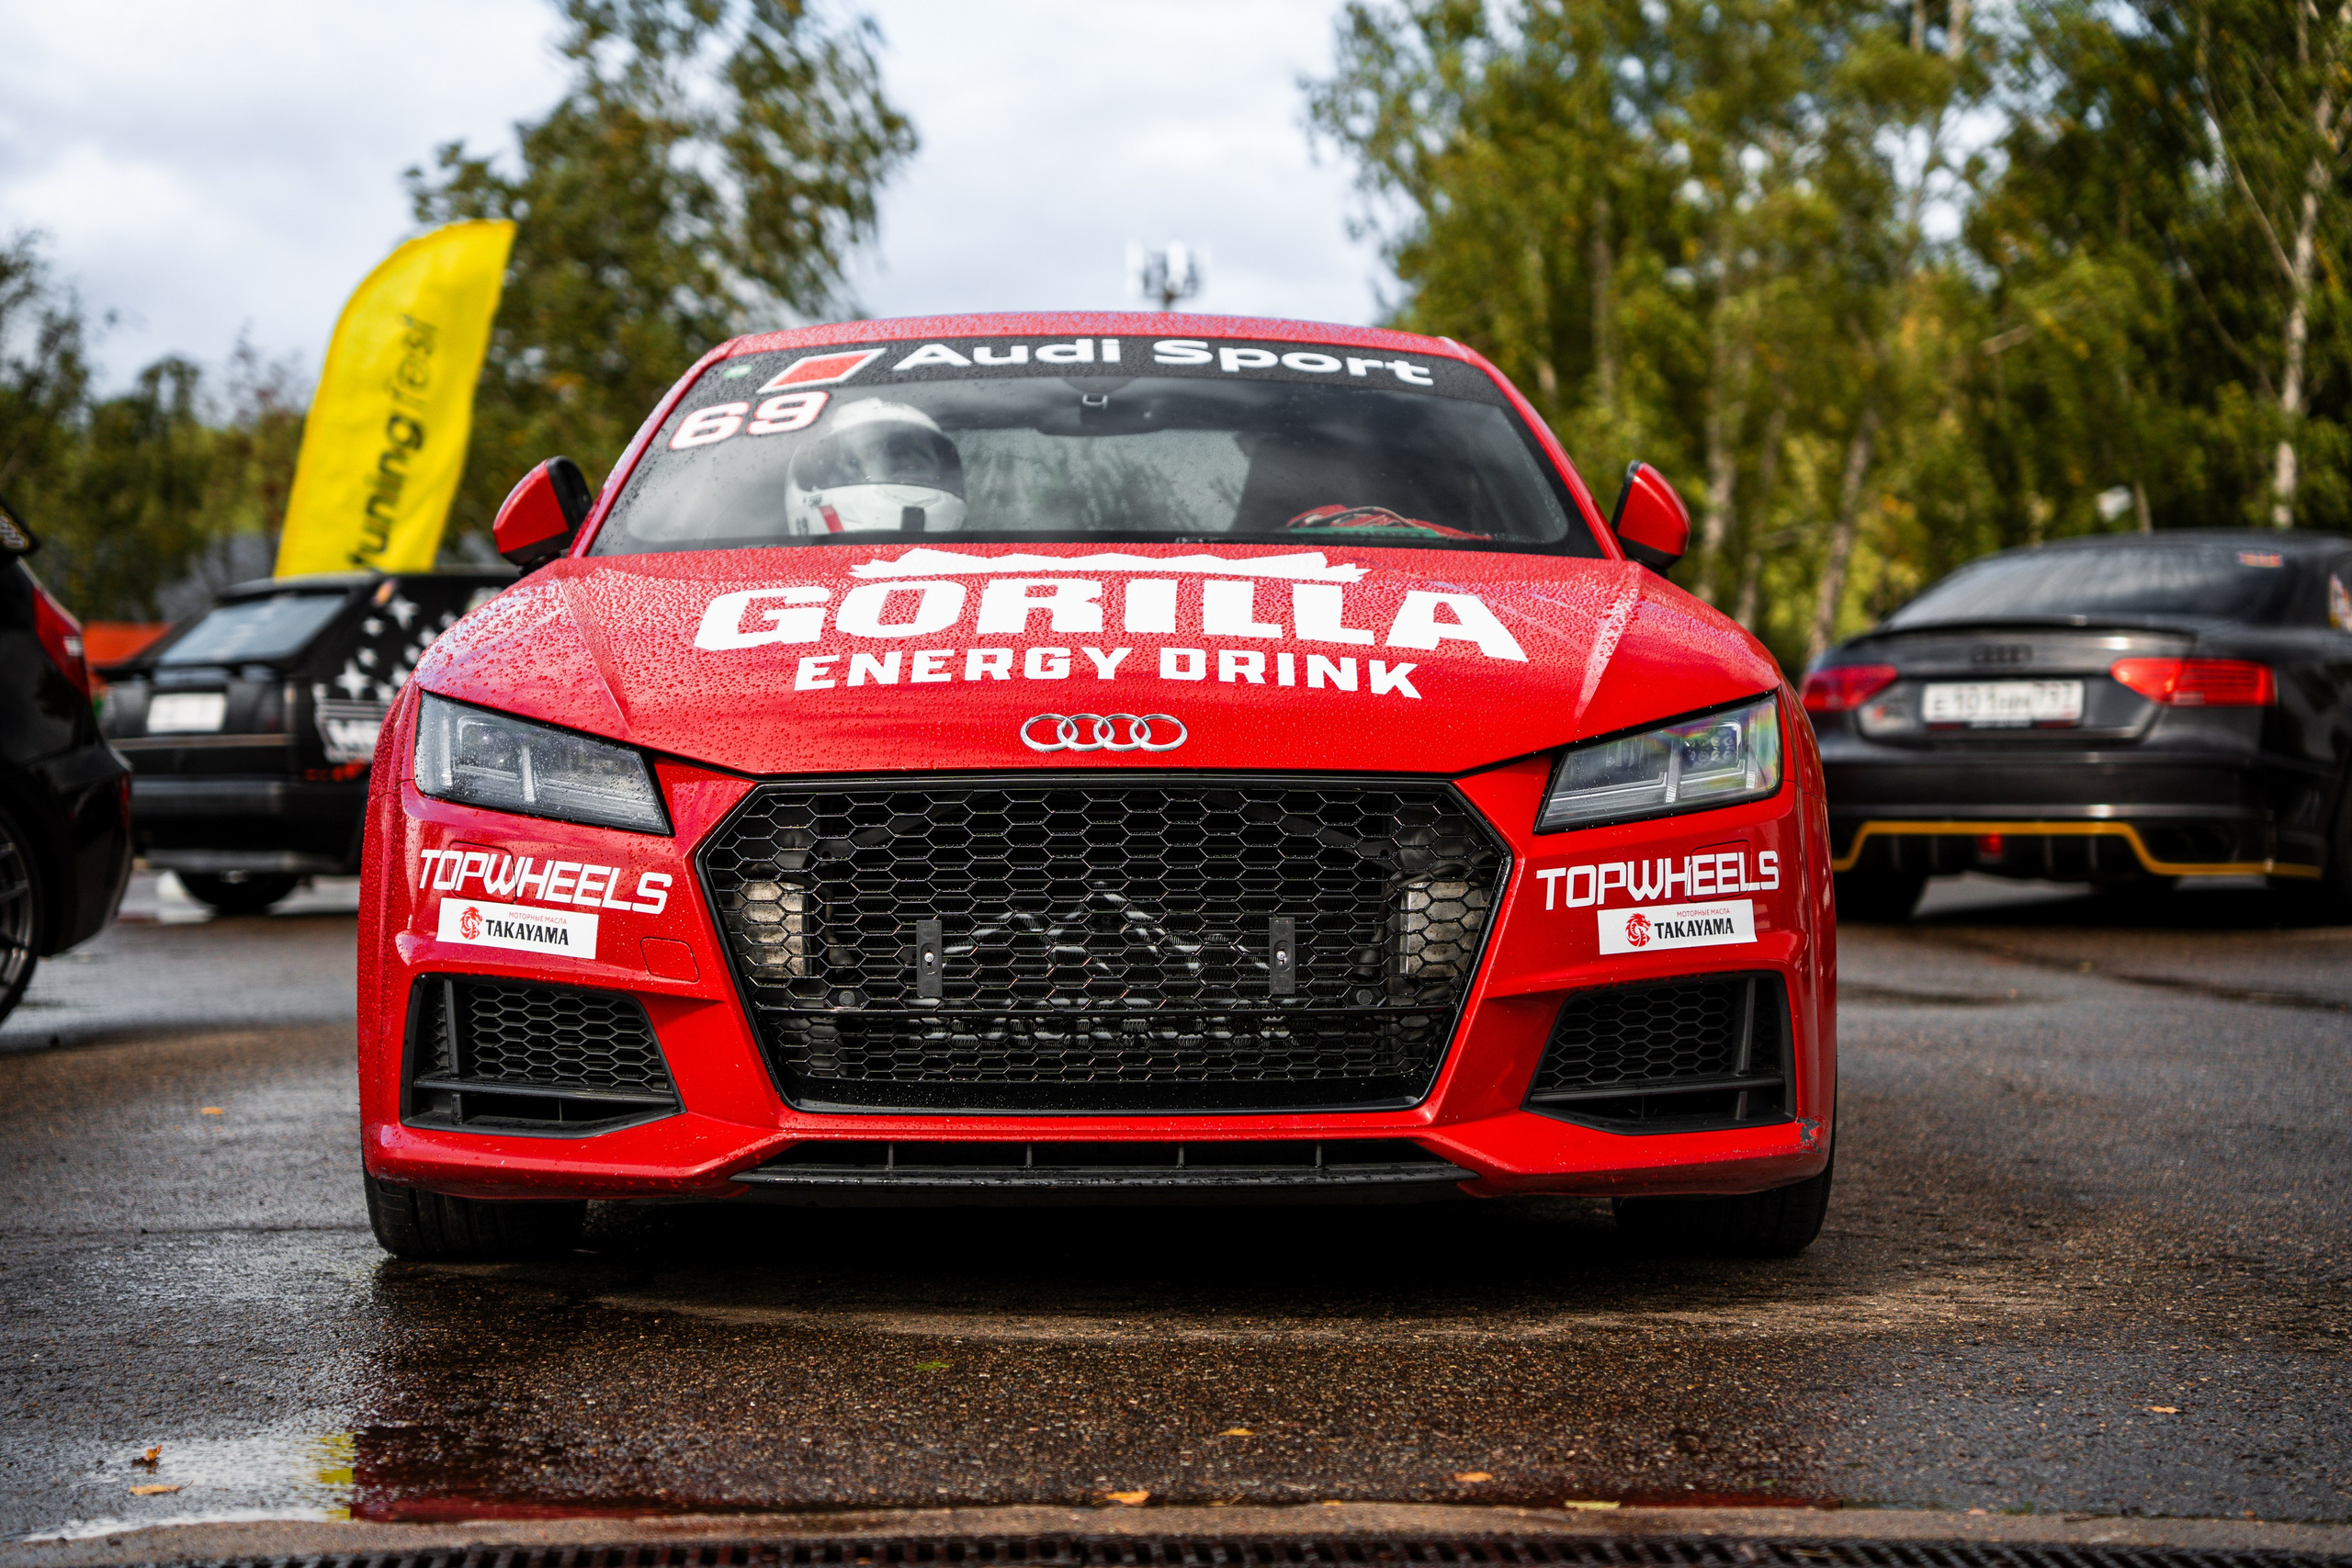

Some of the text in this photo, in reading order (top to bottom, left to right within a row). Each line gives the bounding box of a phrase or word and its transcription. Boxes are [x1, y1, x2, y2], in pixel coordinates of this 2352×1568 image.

[892, 338, 1434, 387] Audi Sport
[669, 390, 829, 450] 69
[694, 578, 1530, 663] GORILLA
[793, 646, 1423, 700] ENERGY DRINK
[419, 849, 673, 915] TOPWHEELS
[1536, 851, 1780, 910] TOPWHEELS
[485, 919, 569, 946] TAKAYAMA
[508, 912, 568, 925] МОТОРНЫЕ МАСЛА
[1654, 918, 1735, 939] TAKAYAMA
